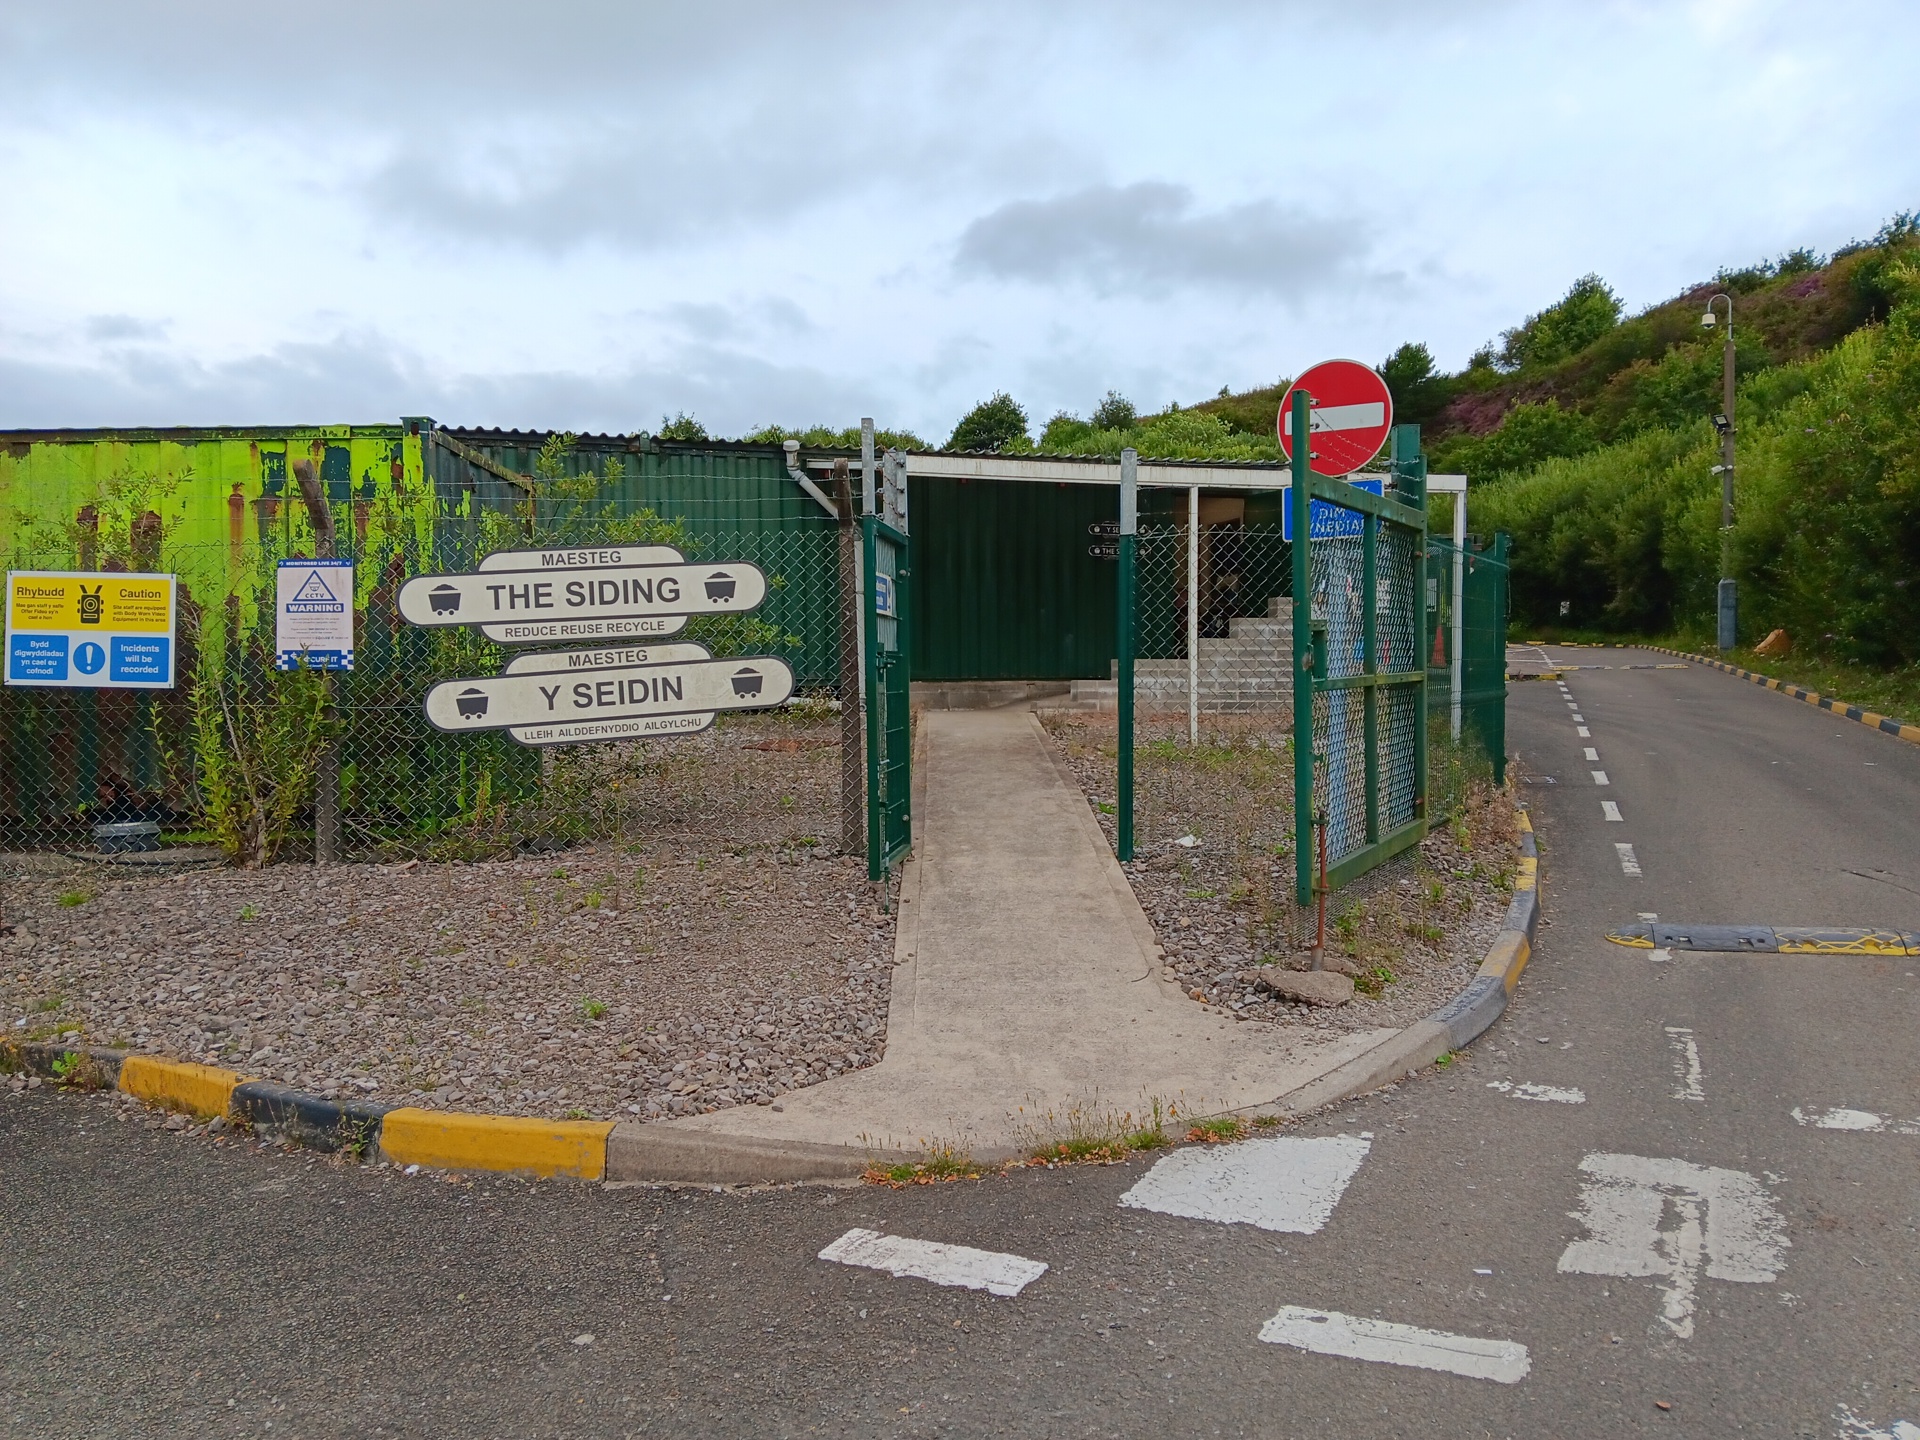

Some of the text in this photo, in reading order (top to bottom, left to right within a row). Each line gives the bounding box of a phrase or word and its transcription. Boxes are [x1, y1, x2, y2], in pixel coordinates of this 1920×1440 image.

[541, 550, 622, 566] MAESTEG
[16, 586, 64, 598] Rhybudd
[119, 588, 161, 598] Caution
[486, 576, 680, 610] THE SIDING
[504, 620, 665, 638] REDUCE REUSE RECYCLE
[30, 641, 49, 650] Bydd
[120, 644, 160, 653] Incidents
[15, 650, 64, 659] digwyddiadau
[568, 650, 648, 668] MAESTEG
[120, 665, 158, 674] recorded
[539, 676, 683, 710] Y SEIDIN
[524, 717, 701, 740] LLEIH AILDDEFNYDDIO AILGYLCHU
